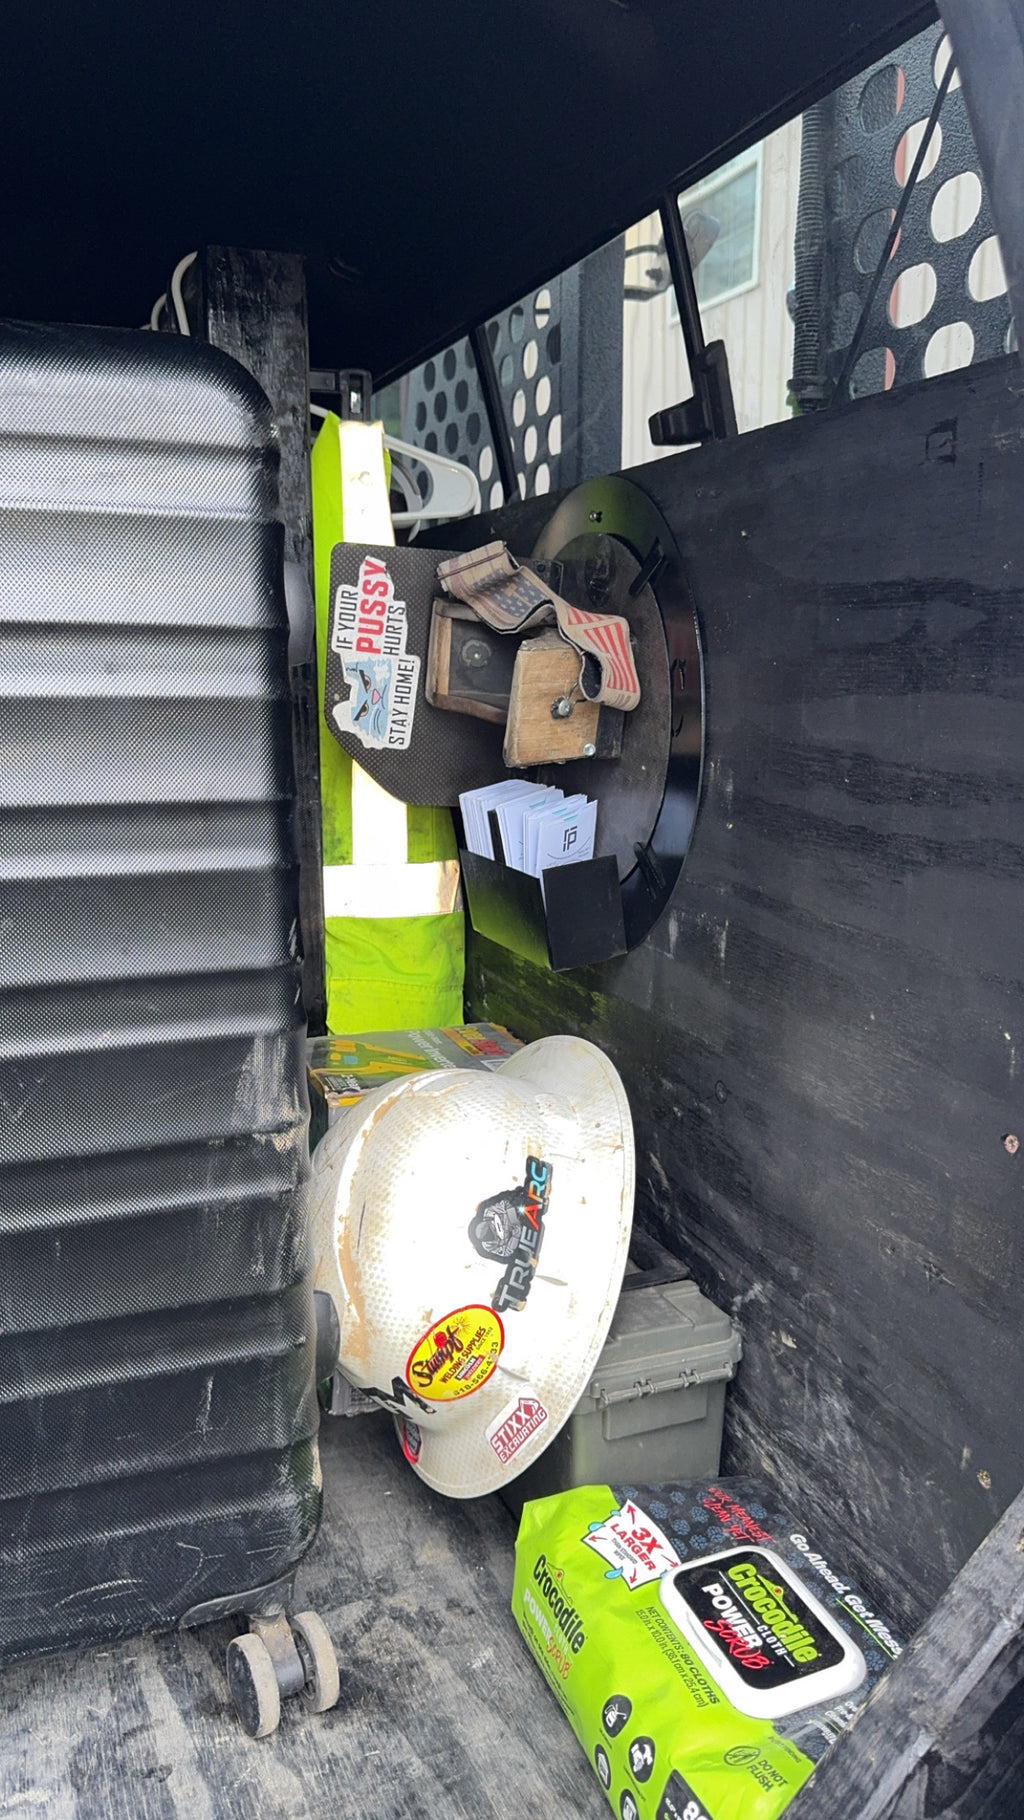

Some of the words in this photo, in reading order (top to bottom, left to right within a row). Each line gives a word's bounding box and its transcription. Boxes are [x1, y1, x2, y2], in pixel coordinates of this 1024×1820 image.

[338, 590, 358, 631] YOUR
[356, 559, 389, 654] PUSSY
[383, 605, 405, 655] HURTS
[336, 635, 353, 649] IF
[394, 659, 415, 705] HOME!
[389, 708, 408, 745] STAY
[440, 1356, 464, 1384] WELDING
[461, 1326, 486, 1359] SUPPLIES
[499, 1409, 546, 1462] EXCAVATING
[708, 1486, 733, 1504] OUR
[729, 1503, 776, 1543] MEANEST
[725, 1523, 755, 1543] YET
[610, 1523, 656, 1571] LARGER
[632, 1527, 664, 1555] 3X
[789, 1533, 810, 1552] Go
[843, 1594, 874, 1619] Get
[523, 1587, 552, 1645] POWER
[533, 1554, 585, 1654] Crocodile
[701, 1582, 763, 1648] POWER
[728, 1563, 818, 1663] Crocodile
[546, 1636, 571, 1680] SCRUB
[646, 1606, 662, 1619] NET
[655, 1619, 685, 1654] CONTENTS:
[680, 1653, 694, 1666] 80
[689, 1666, 720, 1705] CLOTHS
[703, 1618, 770, 1670] SCRUB
[756, 1624, 788, 1656] CLOTH
[693, 1692, 709, 1708] cm)
[746, 1764, 774, 1792] FLUSH
[757, 1759, 770, 1771] DO
[770, 1769, 789, 1787] NOT
